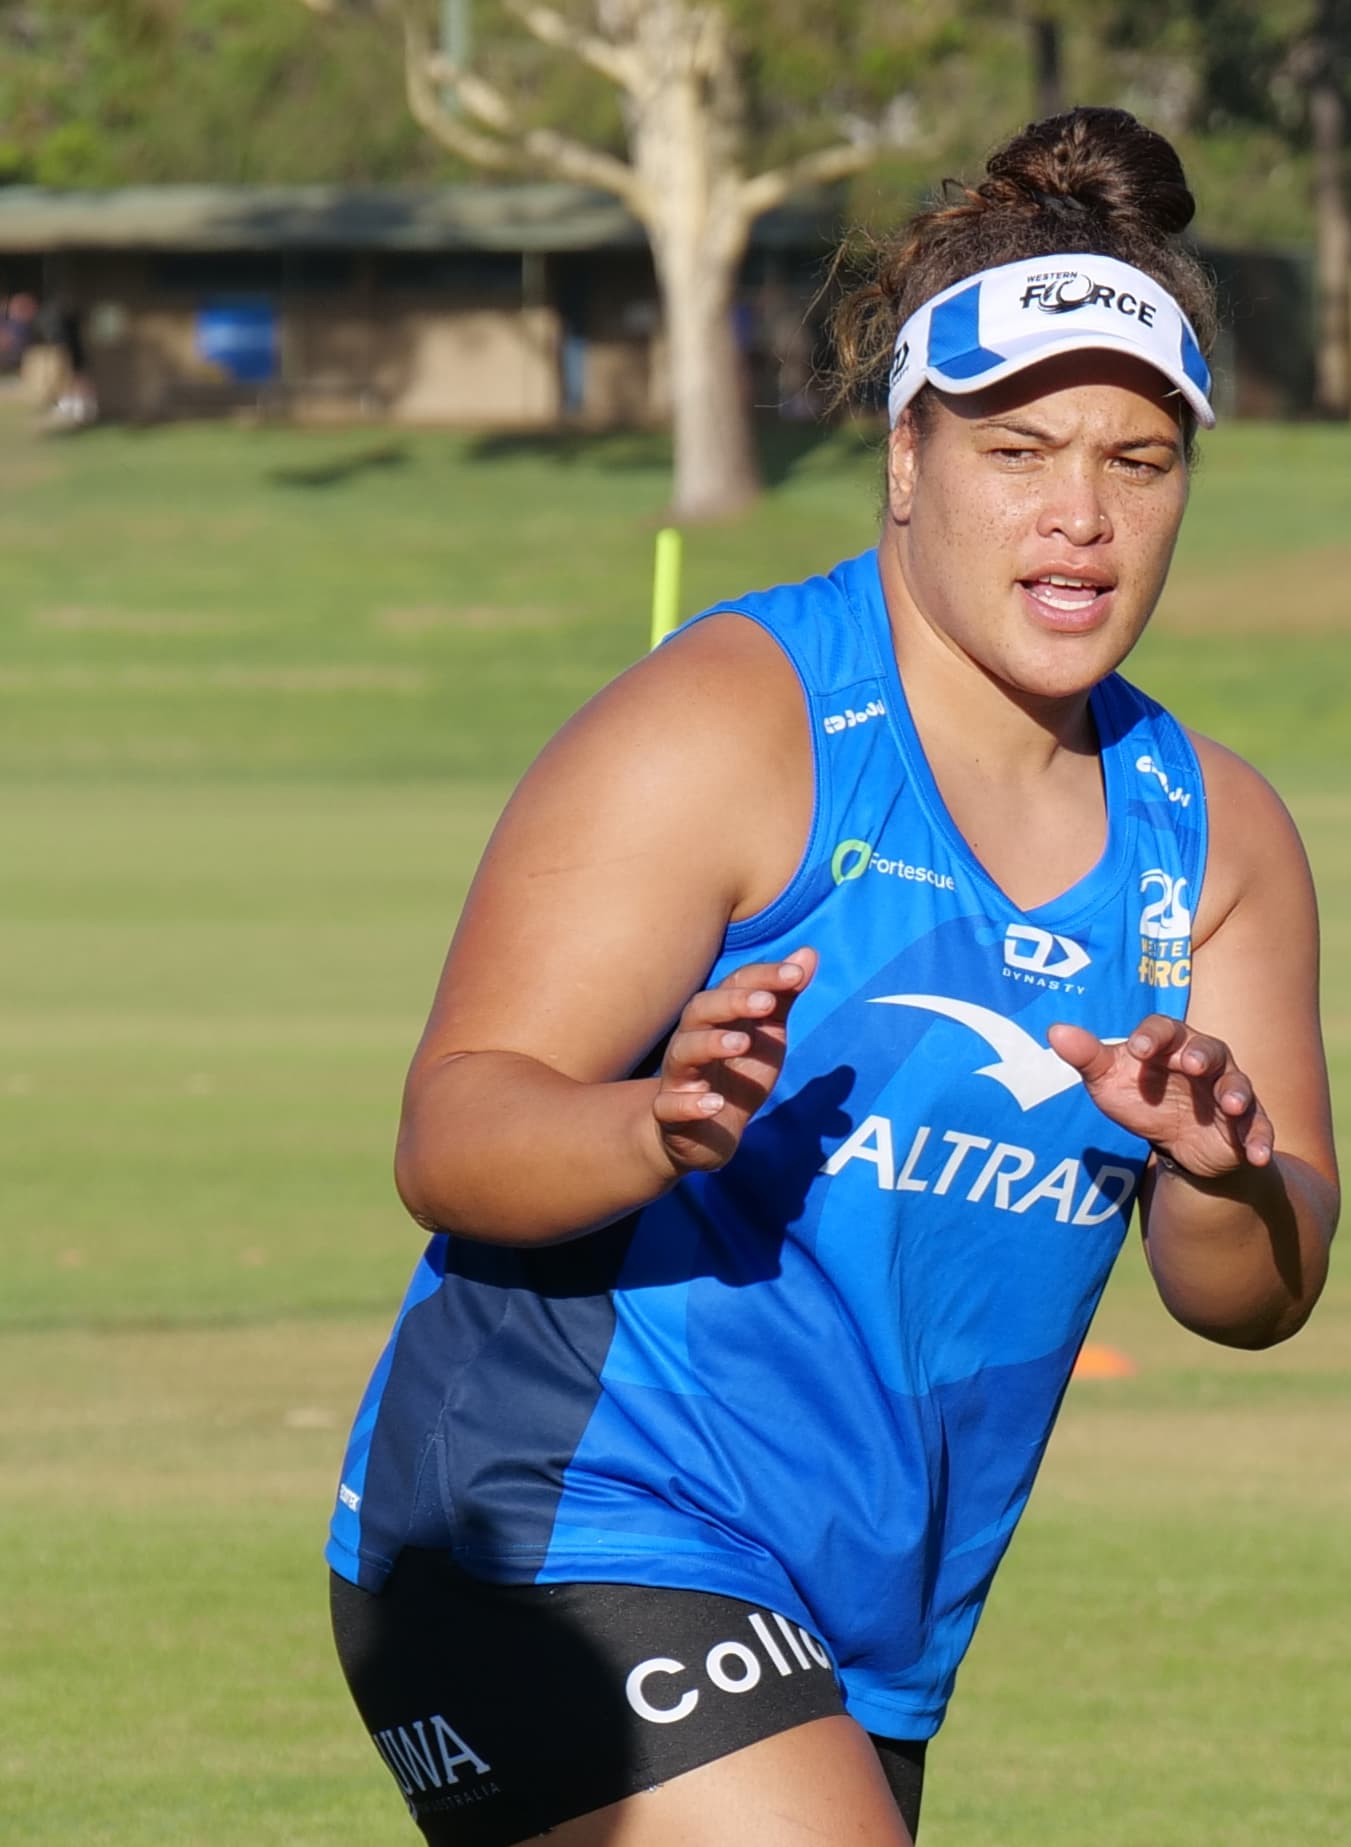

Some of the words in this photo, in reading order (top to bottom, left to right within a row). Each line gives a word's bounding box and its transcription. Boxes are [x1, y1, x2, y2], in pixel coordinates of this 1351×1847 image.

[1026, 271, 1078, 283] WESTERN
[1020, 274, 1157, 328] FORCE
[868, 852, 955, 890] Fortescue
[1002, 967, 1086, 995] DYNASTY
[819, 1114, 1136, 1227] ALTRAD
